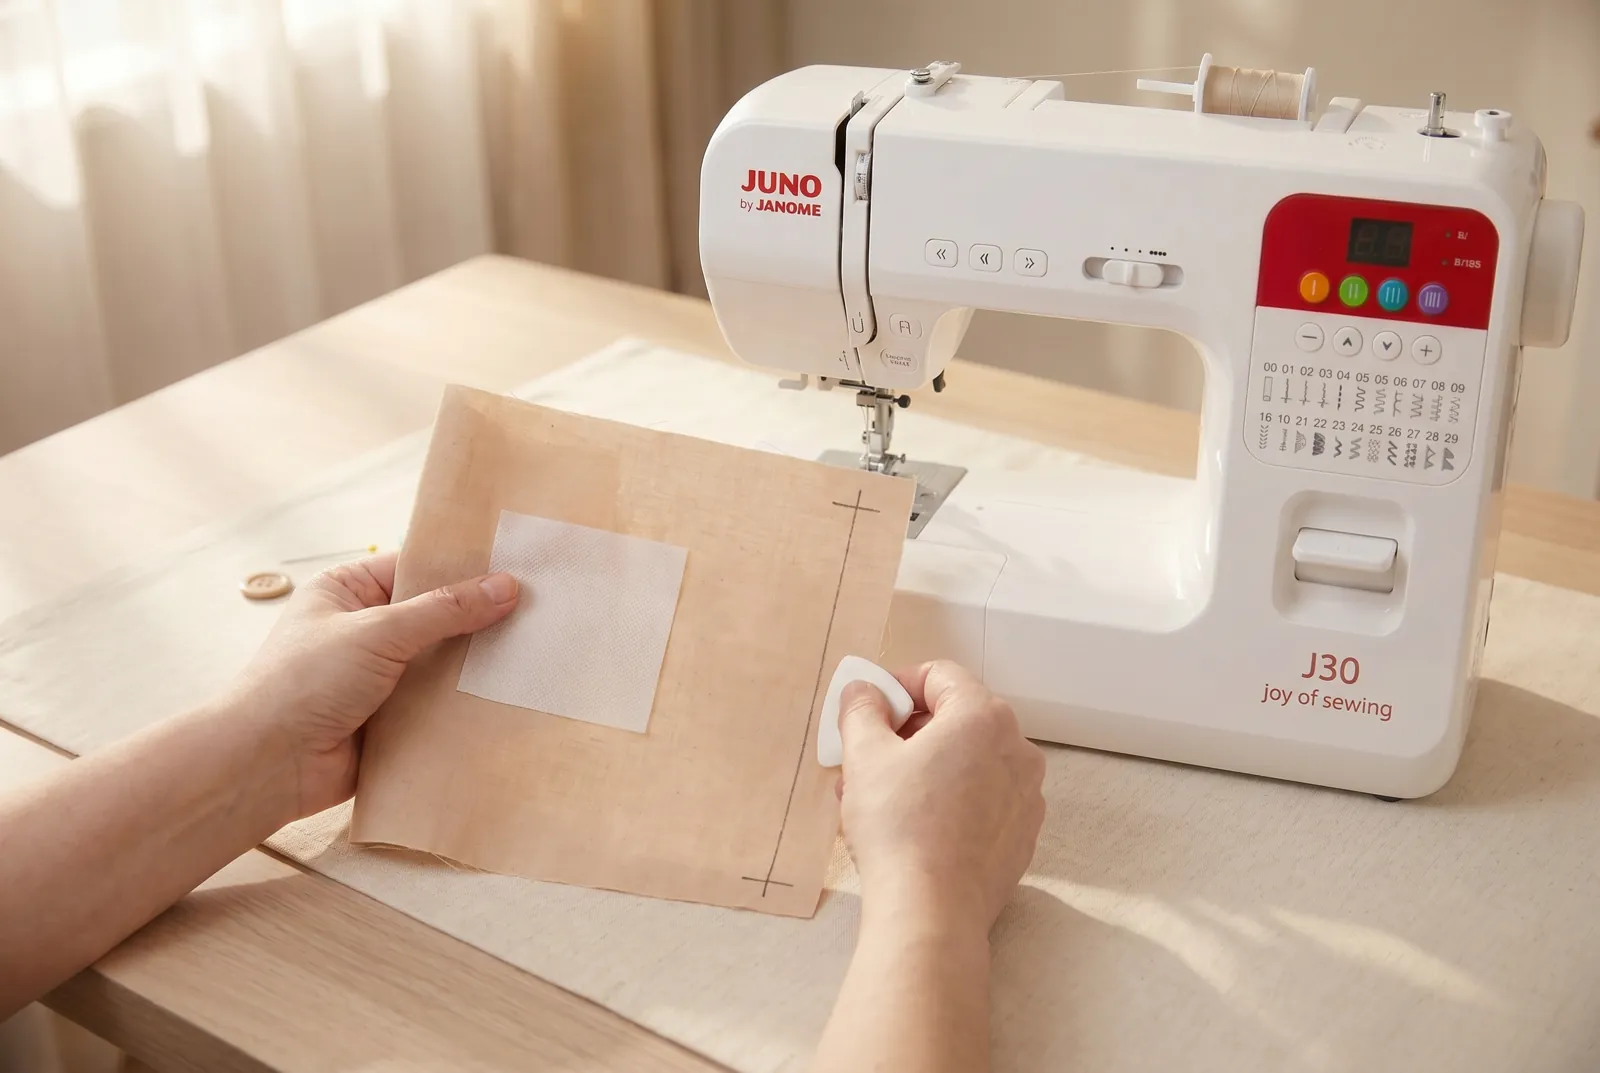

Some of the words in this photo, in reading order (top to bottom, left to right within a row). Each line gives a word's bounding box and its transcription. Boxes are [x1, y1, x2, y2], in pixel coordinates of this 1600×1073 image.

[741, 169, 822, 198] JUNO
[740, 198, 754, 213] by
[756, 198, 822, 217] JANOME
[1264, 362, 1277, 372] 00
[1282, 364, 1294, 374] 01
[1300, 367, 1314, 376] 02
[1319, 369, 1332, 378] 03
[1337, 371, 1350, 380] 04
[1356, 373, 1369, 383] 05
[1375, 375, 1388, 385] 05
[1394, 377, 1407, 387] 06
[1412, 379, 1426, 388] 07
[1431, 381, 1445, 391] 08
[1451, 383, 1465, 393] 09
[1260, 412, 1271, 422] 16
[1278, 415, 1290, 424] 10
[1296, 417, 1307, 426] 21
[1314, 419, 1327, 428] 22
[1332, 421, 1345, 430] 23
[1351, 423, 1364, 432] 24
[1369, 425, 1383, 435] 25
[1388, 427, 1401, 437] 26
[1407, 429, 1420, 438] 27
[1426, 431, 1439, 441] 28
[1444, 433, 1458, 443] 29
[1301, 652, 1360, 684] J30
[1261, 683, 1293, 706] joy
[1298, 689, 1319, 706] of
[1322, 695, 1393, 722] sewing
